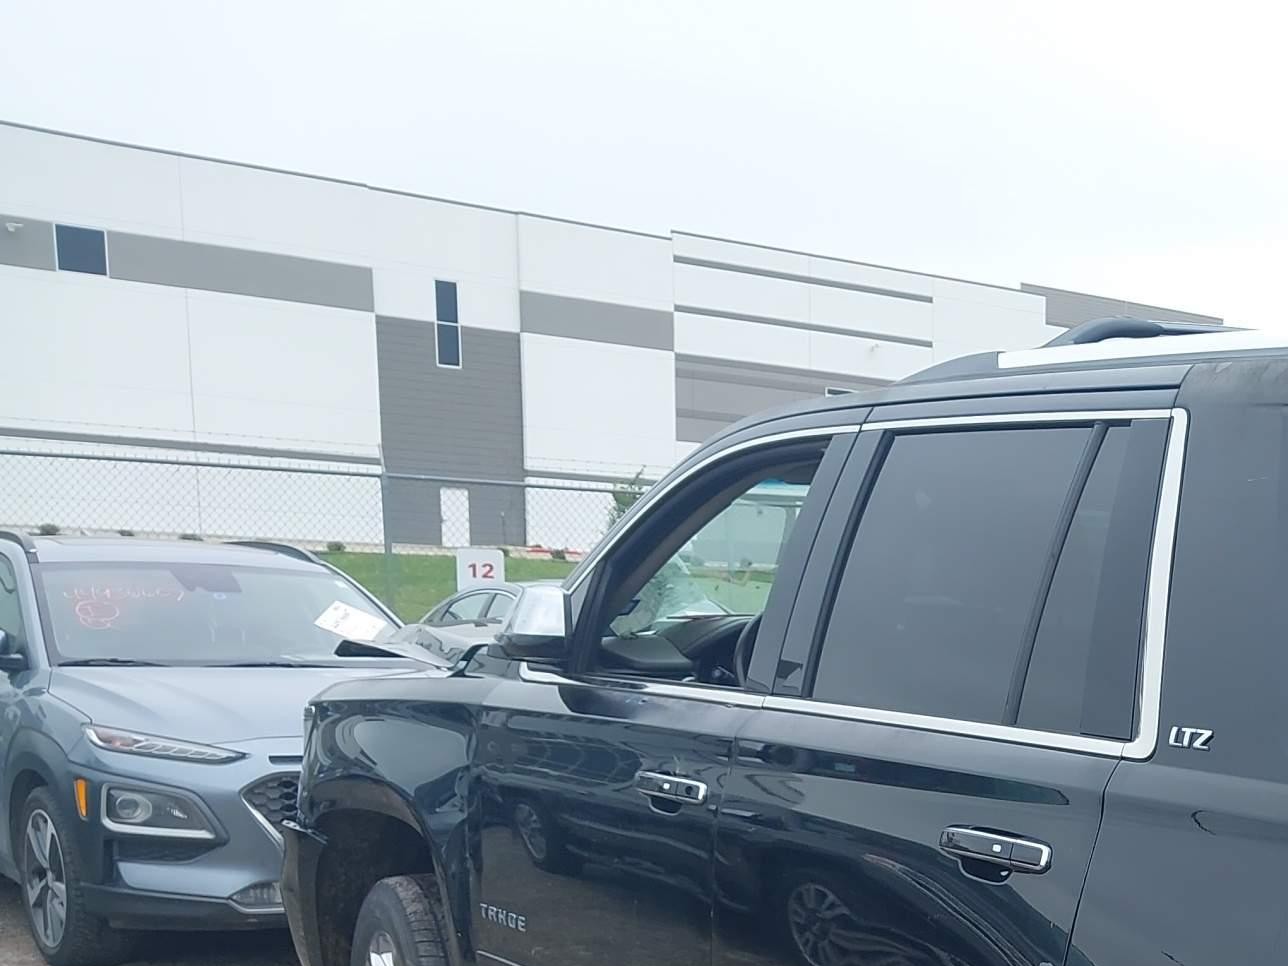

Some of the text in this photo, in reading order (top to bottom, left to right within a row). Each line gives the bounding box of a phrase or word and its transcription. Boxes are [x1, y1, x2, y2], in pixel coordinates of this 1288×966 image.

[468, 563, 495, 579] 12
[1168, 726, 1214, 751] LTZ
[479, 902, 527, 932] TAHOE
